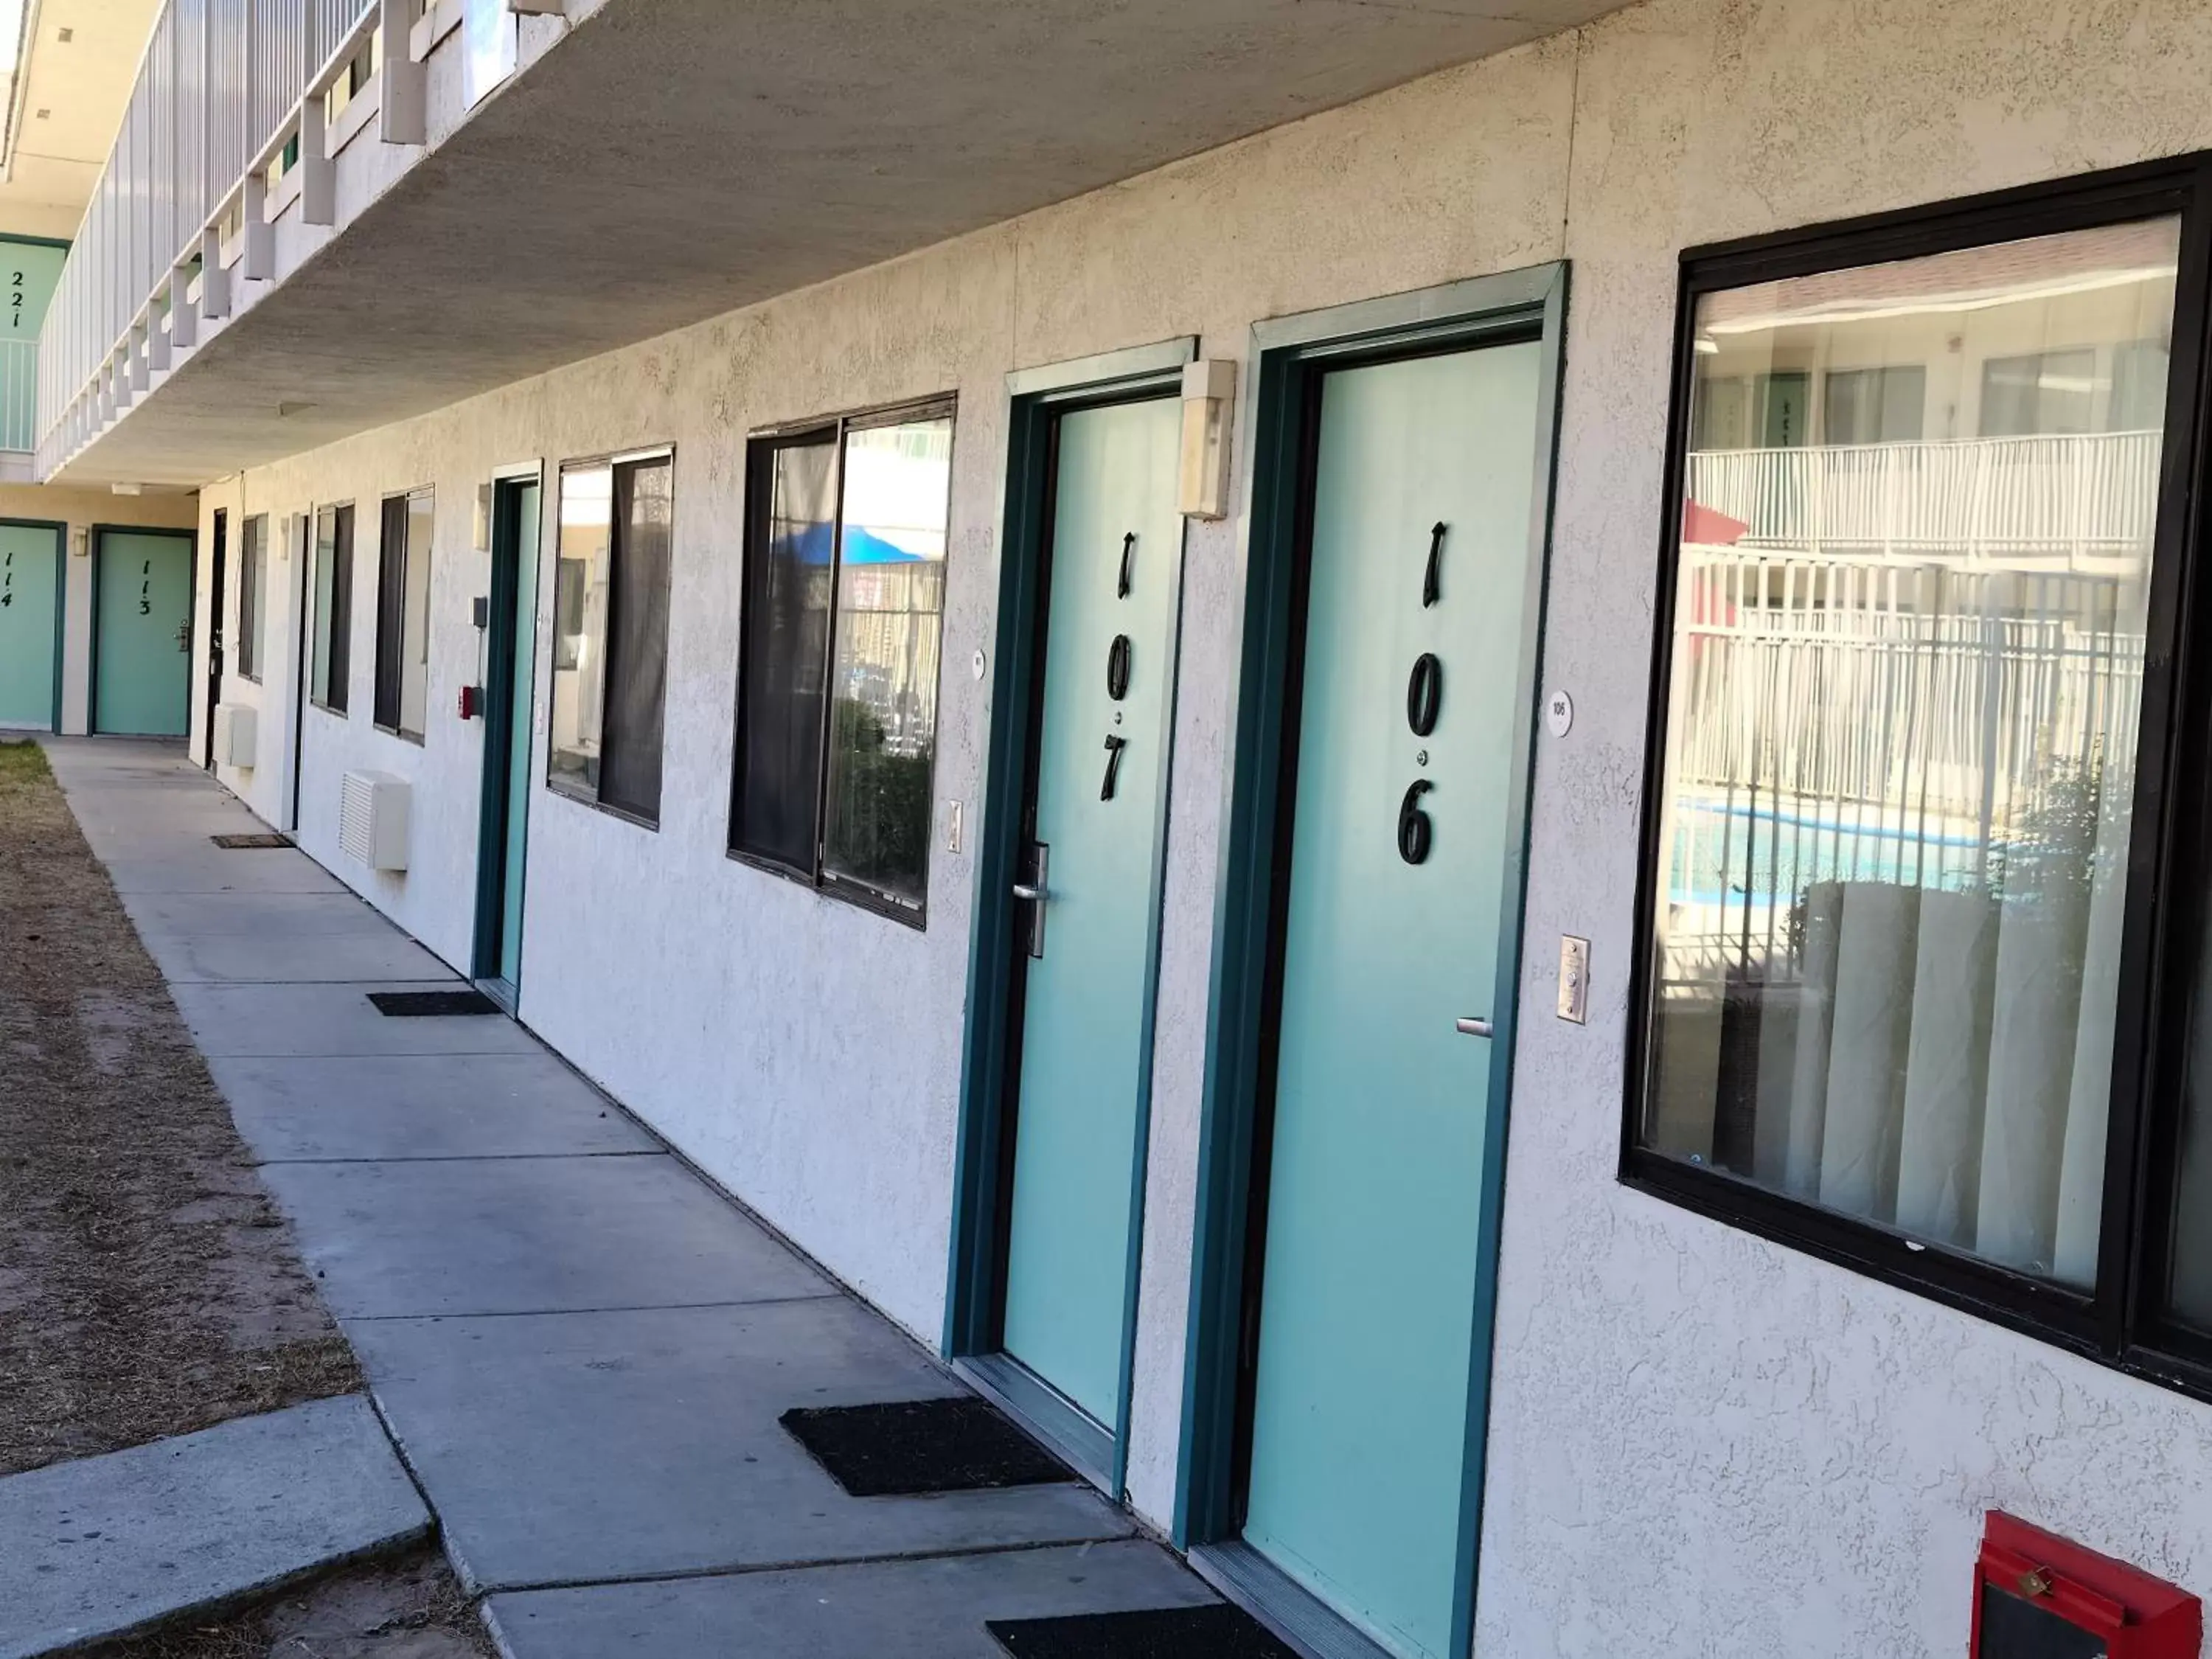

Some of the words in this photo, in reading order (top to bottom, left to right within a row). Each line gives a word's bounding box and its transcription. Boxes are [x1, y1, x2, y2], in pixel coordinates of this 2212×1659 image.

[12, 271, 24, 327] 221
[1, 552, 13, 607] 114
[139, 560, 150, 615] 113
[1100, 531, 1137, 801] 107
[1397, 521, 1449, 865] 106
